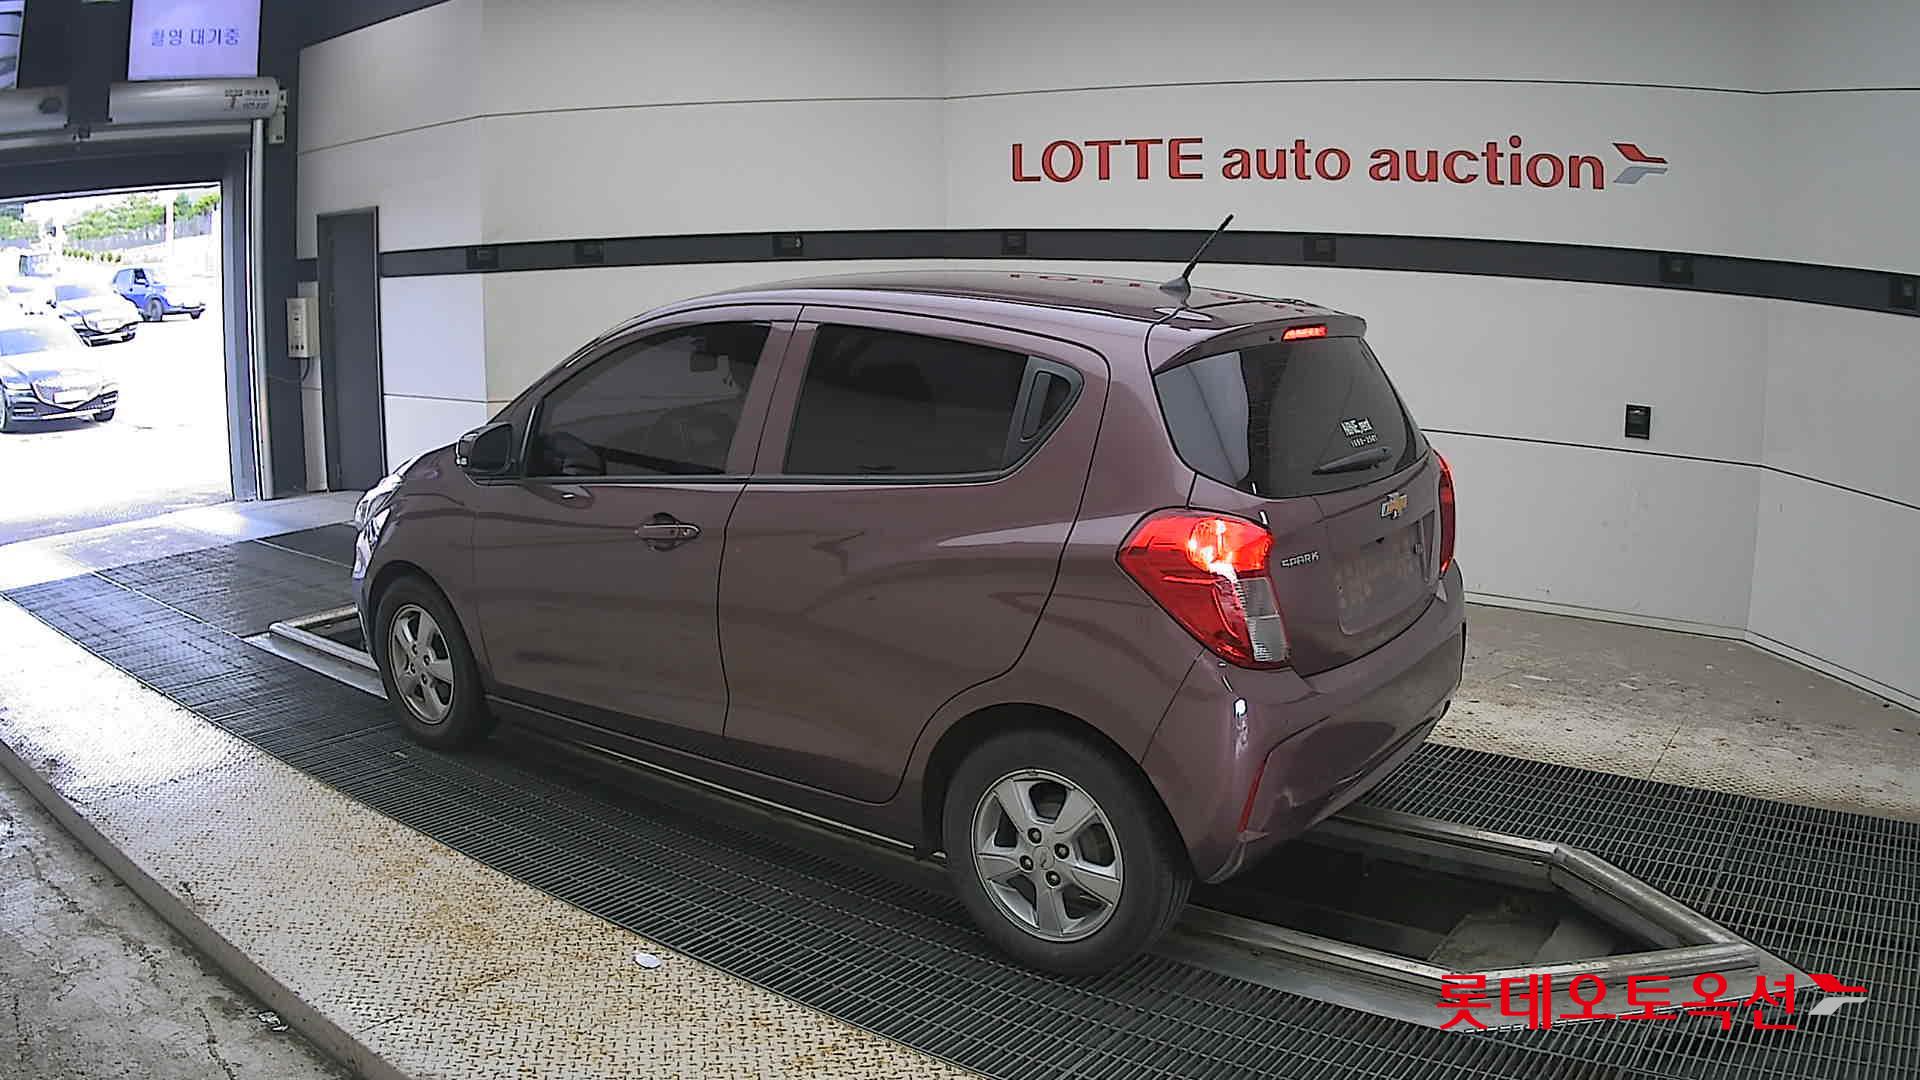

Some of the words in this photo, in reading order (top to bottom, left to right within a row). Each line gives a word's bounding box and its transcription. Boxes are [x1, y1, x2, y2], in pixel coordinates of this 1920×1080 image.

[190, 28, 239, 47] 대기중
[1012, 138, 1204, 182] LOTTE
[1222, 139, 1352, 181] auto
[1370, 135, 1606, 190] auction
[1280, 551, 1320, 568] SPARK
